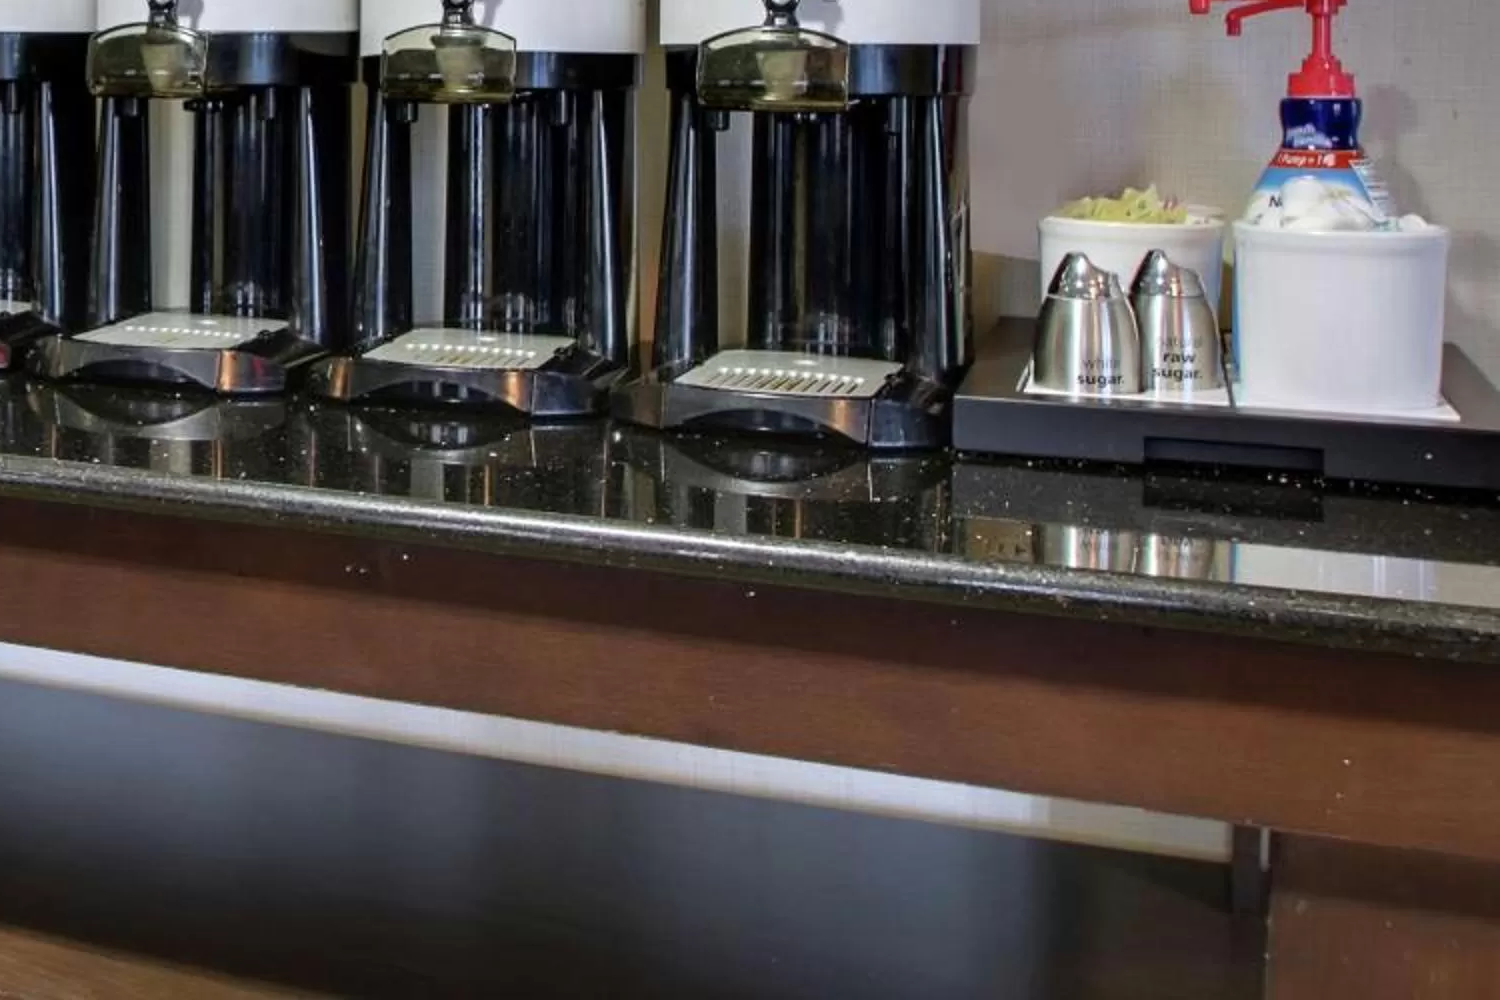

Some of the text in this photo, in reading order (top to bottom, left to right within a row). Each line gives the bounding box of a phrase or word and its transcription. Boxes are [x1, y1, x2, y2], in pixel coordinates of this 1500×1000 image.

[1163, 351, 1196, 363] raw
[1077, 374, 1124, 389] sugar.
[1153, 366, 1203, 382] sugar.
